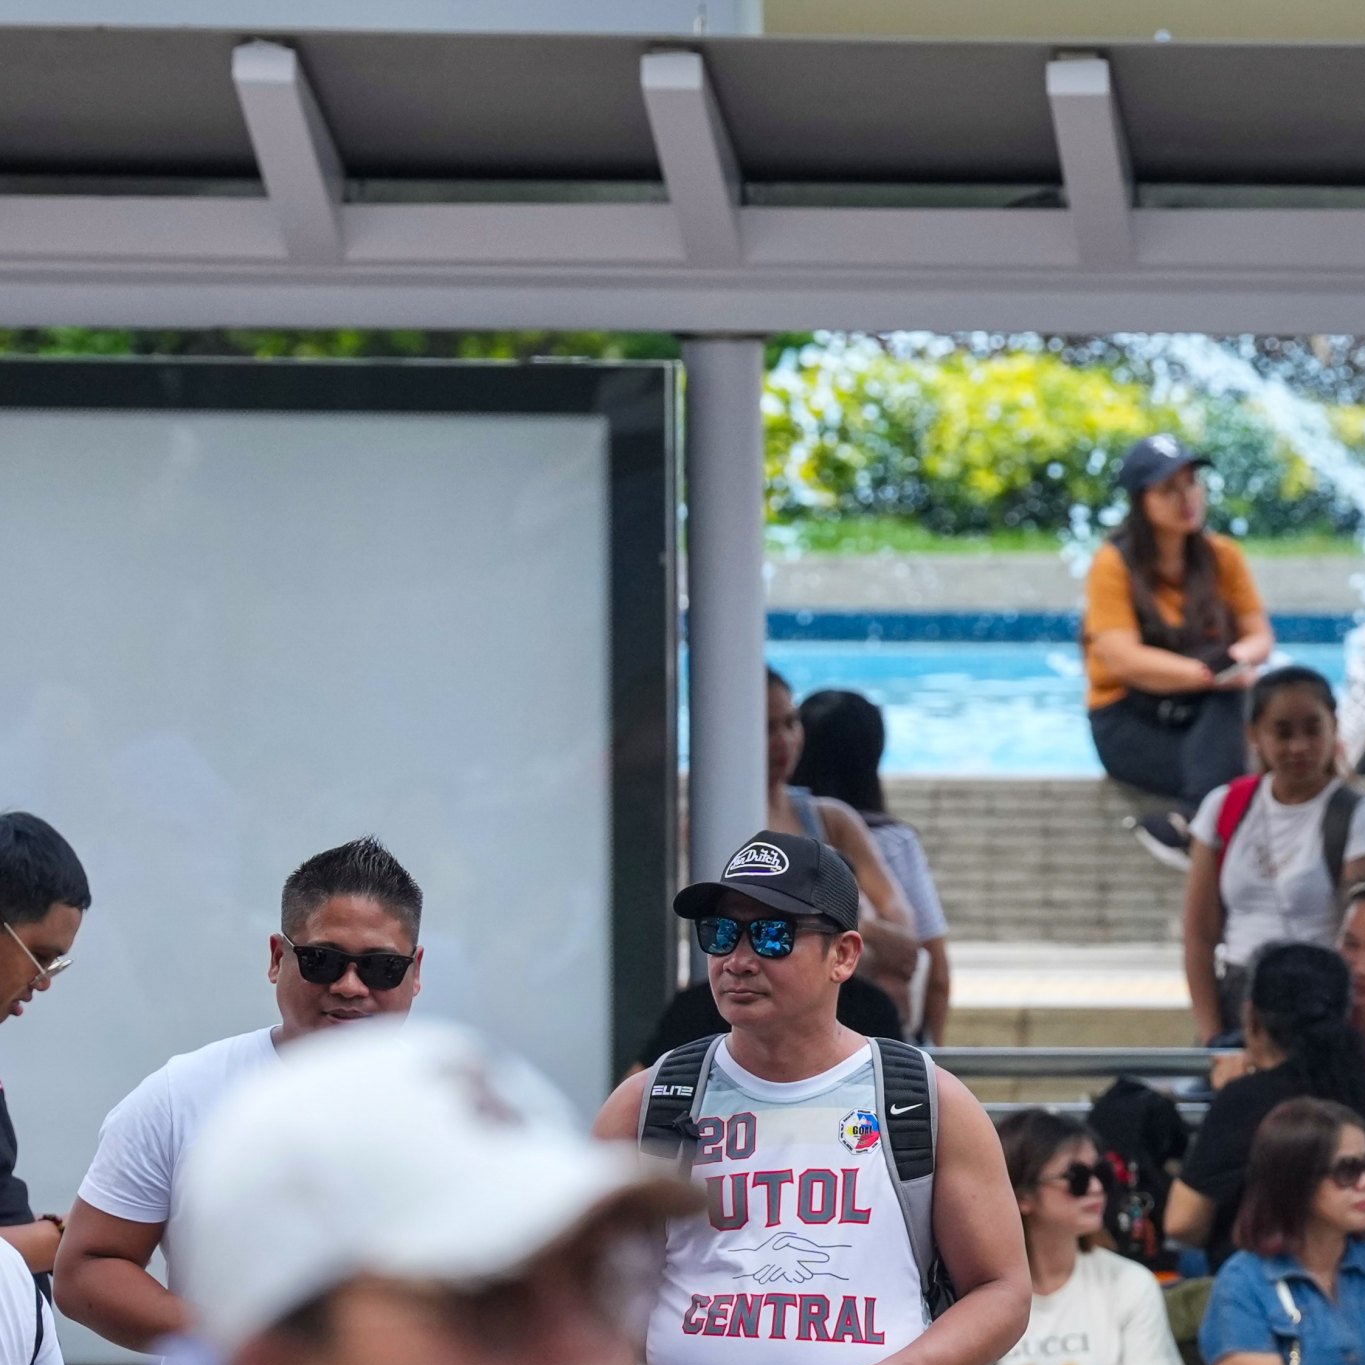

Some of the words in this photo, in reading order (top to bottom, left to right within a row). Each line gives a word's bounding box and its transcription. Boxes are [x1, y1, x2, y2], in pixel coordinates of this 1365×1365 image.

[743, 848, 781, 867] Dutch
[692, 1111, 757, 1166] 20
[705, 1167, 872, 1232] UTOL
[682, 1292, 886, 1345] CENTRAL
